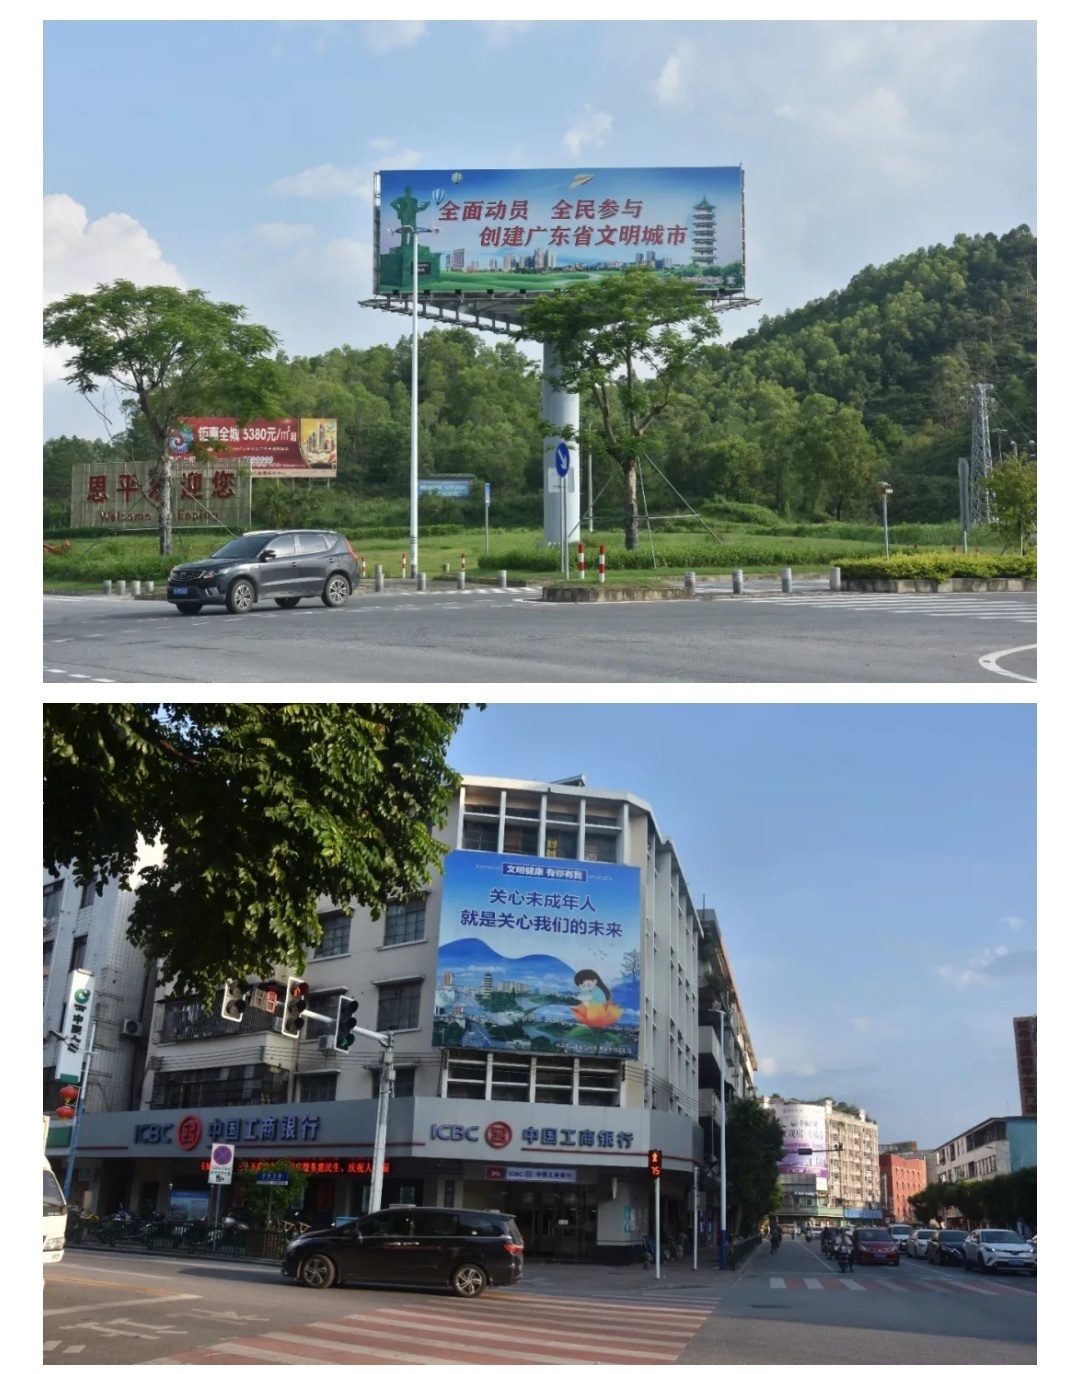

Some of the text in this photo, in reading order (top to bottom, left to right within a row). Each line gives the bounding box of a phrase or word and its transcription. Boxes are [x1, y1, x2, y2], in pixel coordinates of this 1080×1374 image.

[438, 198, 643, 222] 全面动员 全民参与
[479, 225, 688, 248] 创建广东省文明城市
[489, 888, 597, 913] 关心未成年人
[460, 909, 624, 938] 就是关心我们的未来
[134, 1124, 174, 1144] ICBC
[208, 1116, 321, 1142] 中国工商银行
[430, 1123, 480, 1143] ICBC
[522, 1126, 635, 1149] 中国工商银行
